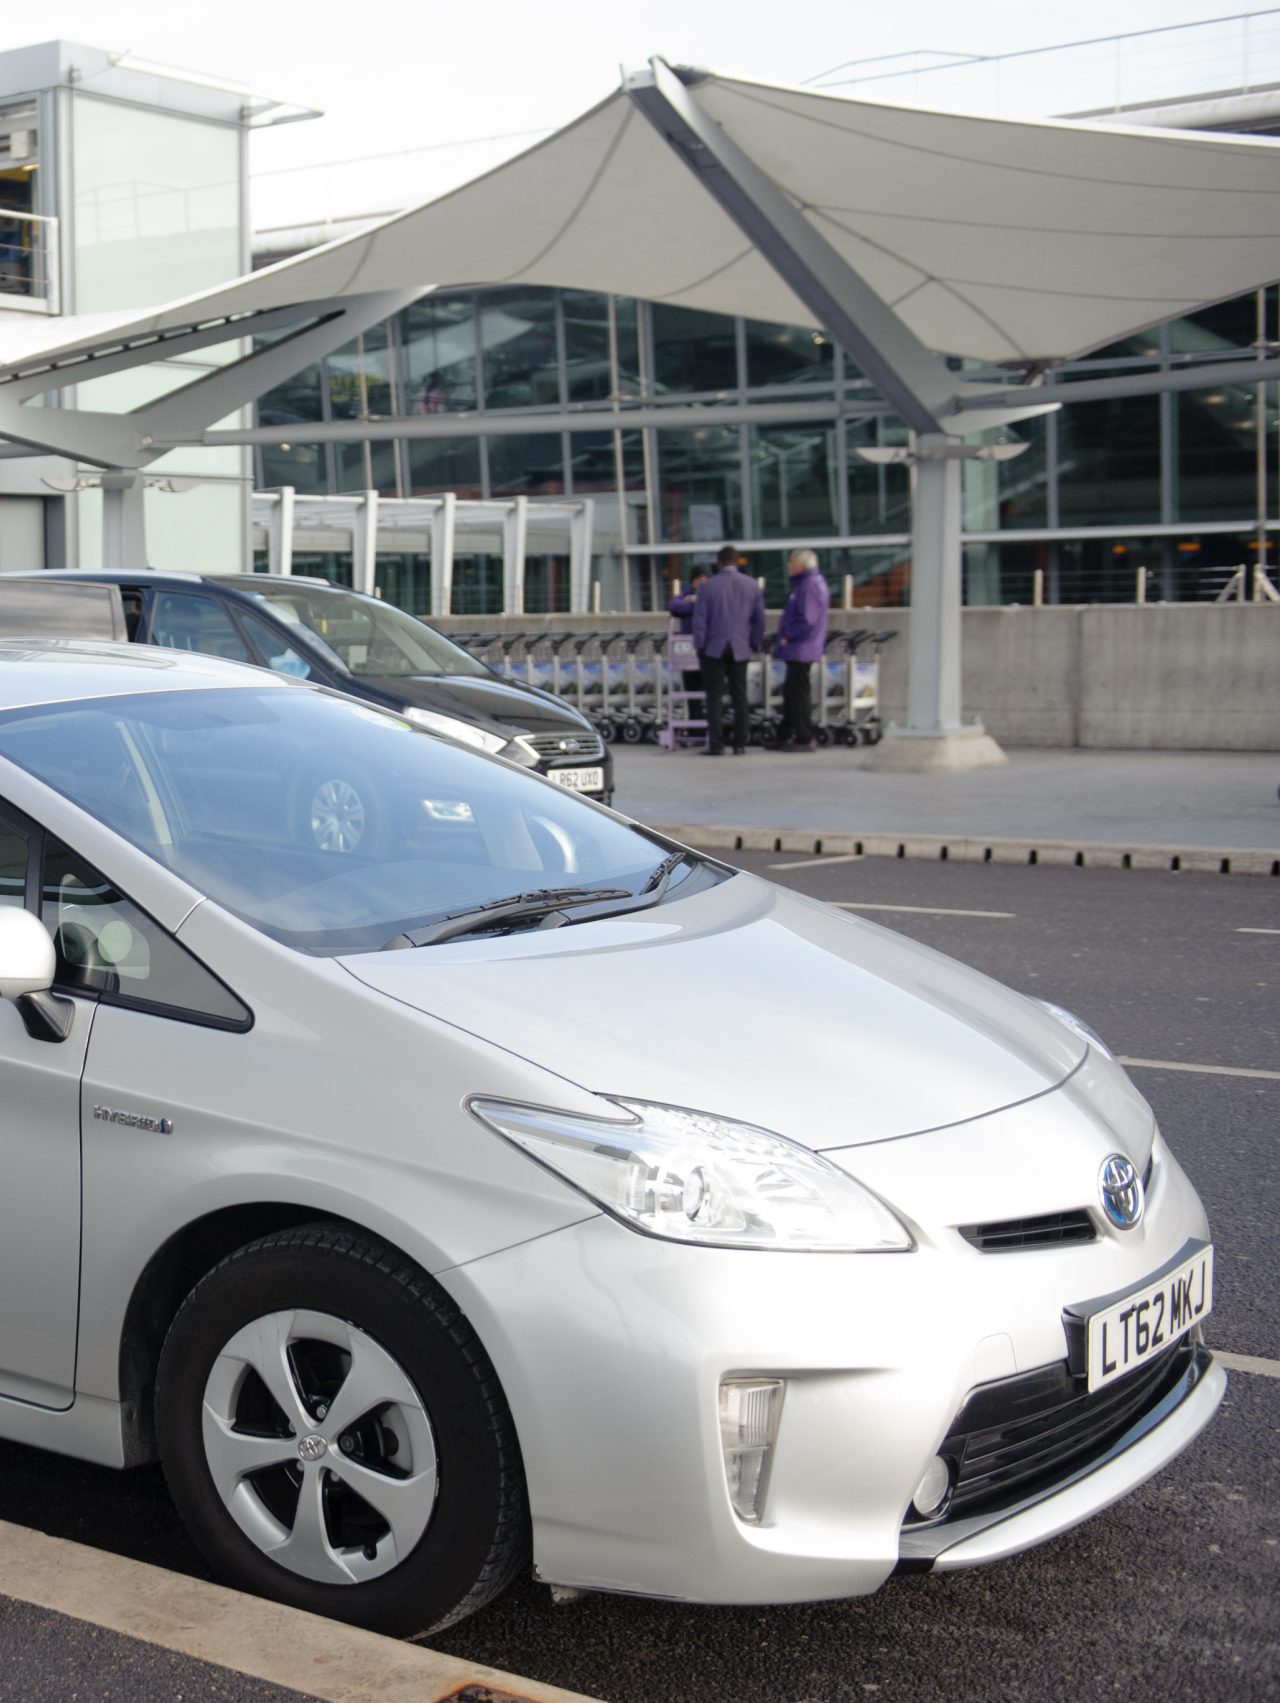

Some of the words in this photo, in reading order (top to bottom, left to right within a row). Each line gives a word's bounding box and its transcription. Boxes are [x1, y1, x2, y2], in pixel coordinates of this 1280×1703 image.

[94, 1104, 160, 1132] HYBRID
[1102, 1291, 1165, 1377] LT62
[1170, 1260, 1206, 1336] MKJ
